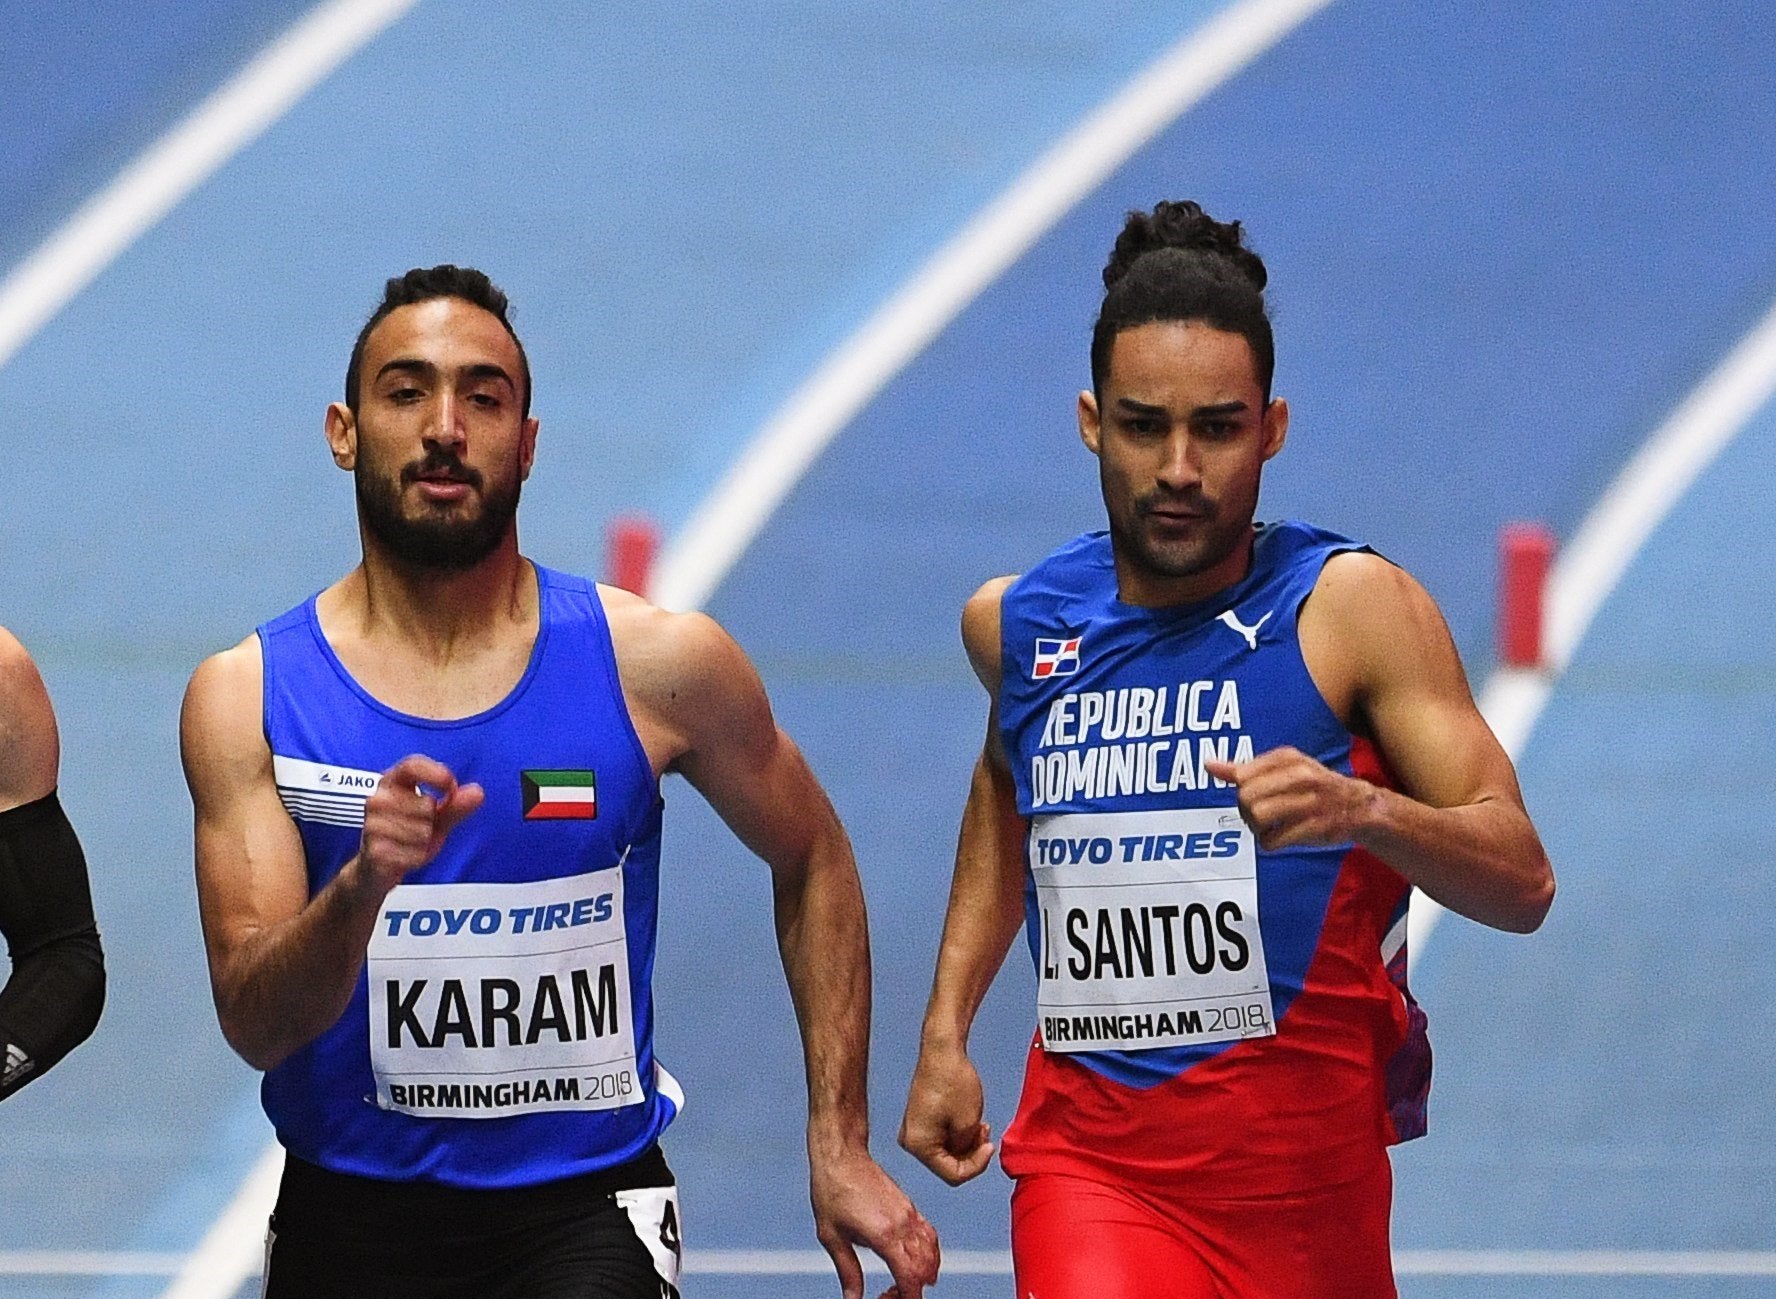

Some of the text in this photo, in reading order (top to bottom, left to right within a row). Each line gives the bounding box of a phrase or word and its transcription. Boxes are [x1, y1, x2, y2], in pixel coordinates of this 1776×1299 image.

[337, 775, 375, 788] JAKO
[1038, 830, 1242, 865] TOYO TIRES
[384, 893, 614, 937] TOYO TIRES
[1066, 902, 1250, 981] SANTOS
[386, 963, 619, 1049] KARAM
[1044, 1004, 1265, 1041] BIRMINGHAM 2018
[389, 1070, 633, 1109] BIRMINGHAM 2018
